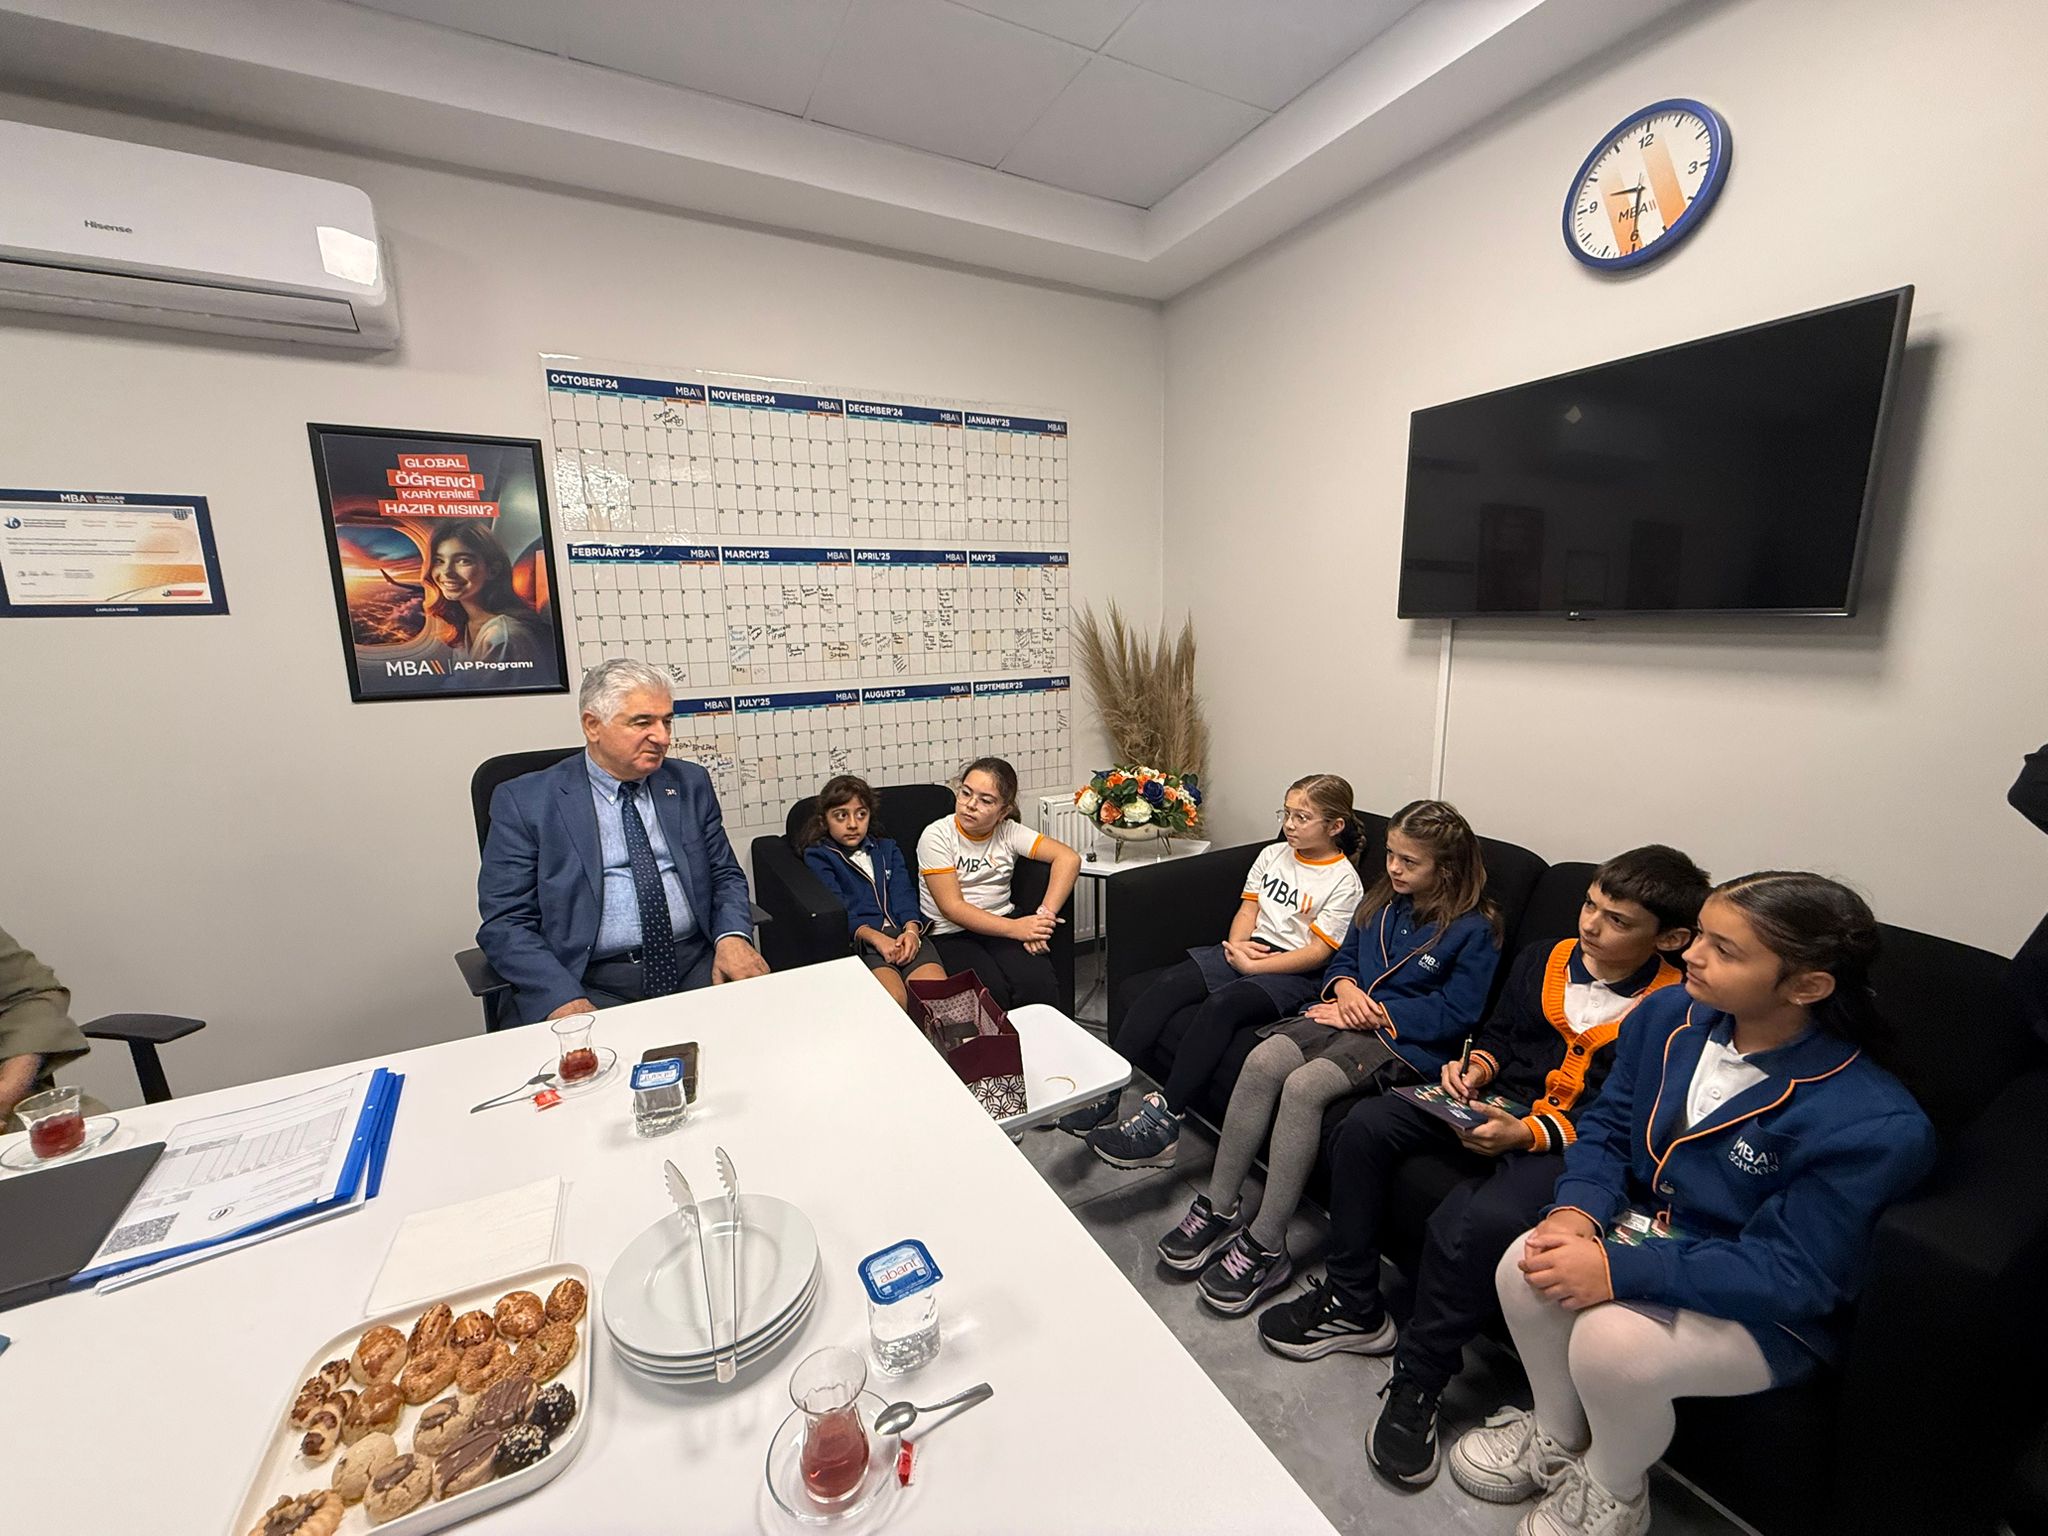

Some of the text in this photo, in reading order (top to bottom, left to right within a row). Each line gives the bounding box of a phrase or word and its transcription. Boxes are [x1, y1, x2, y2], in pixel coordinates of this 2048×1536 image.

[1639, 133, 1654, 149] 12
[1688, 161, 1698, 174] 3
[1589, 201, 1597, 213] 9
[84, 219, 133, 233] Hisense
[1630, 229, 1639, 241] 6
[551, 374, 618, 390] OCTOBER'24
[675, 386, 696, 397] MBA
[711, 390, 776, 405] NOVEMBER'24
[817, 400, 836, 410] MBA
[848, 404, 903, 417] DECEMBER'24
[940, 412, 956, 421] MBA
[967, 416, 1010, 426] JANUARY'25
[1047, 423, 1061, 432] MBA
[404, 458, 466, 468] GLOBAL
[395, 471, 476, 488] ÖĞRENCİ
[60, 493, 88, 503] MBA
[402, 489, 475, 499] KARİYERİNE
[385, 503, 494, 515] HAZIR MISIN?
[572, 548, 642, 558] FEBRUARY'25
[690, 550, 710, 558] MBA
[725, 550, 770, 559] MARCH'25
[857, 552, 890, 560] APRIL'25
[386, 660, 533, 677] MBA AP Programı
[976, 682, 1023, 692] SEPTEMBER'25
[836, 692, 852, 701] MBA
[865, 689, 906, 698] AUGUST'25
[704, 700, 724, 710] MBA
[738, 698, 770, 708] JULY'25
[957, 855, 992, 872] MBA
[1261, 874, 1298, 911] MBA
[1733, 1136, 1769, 1166] MBA
[880, 1258, 918, 1283] abant
